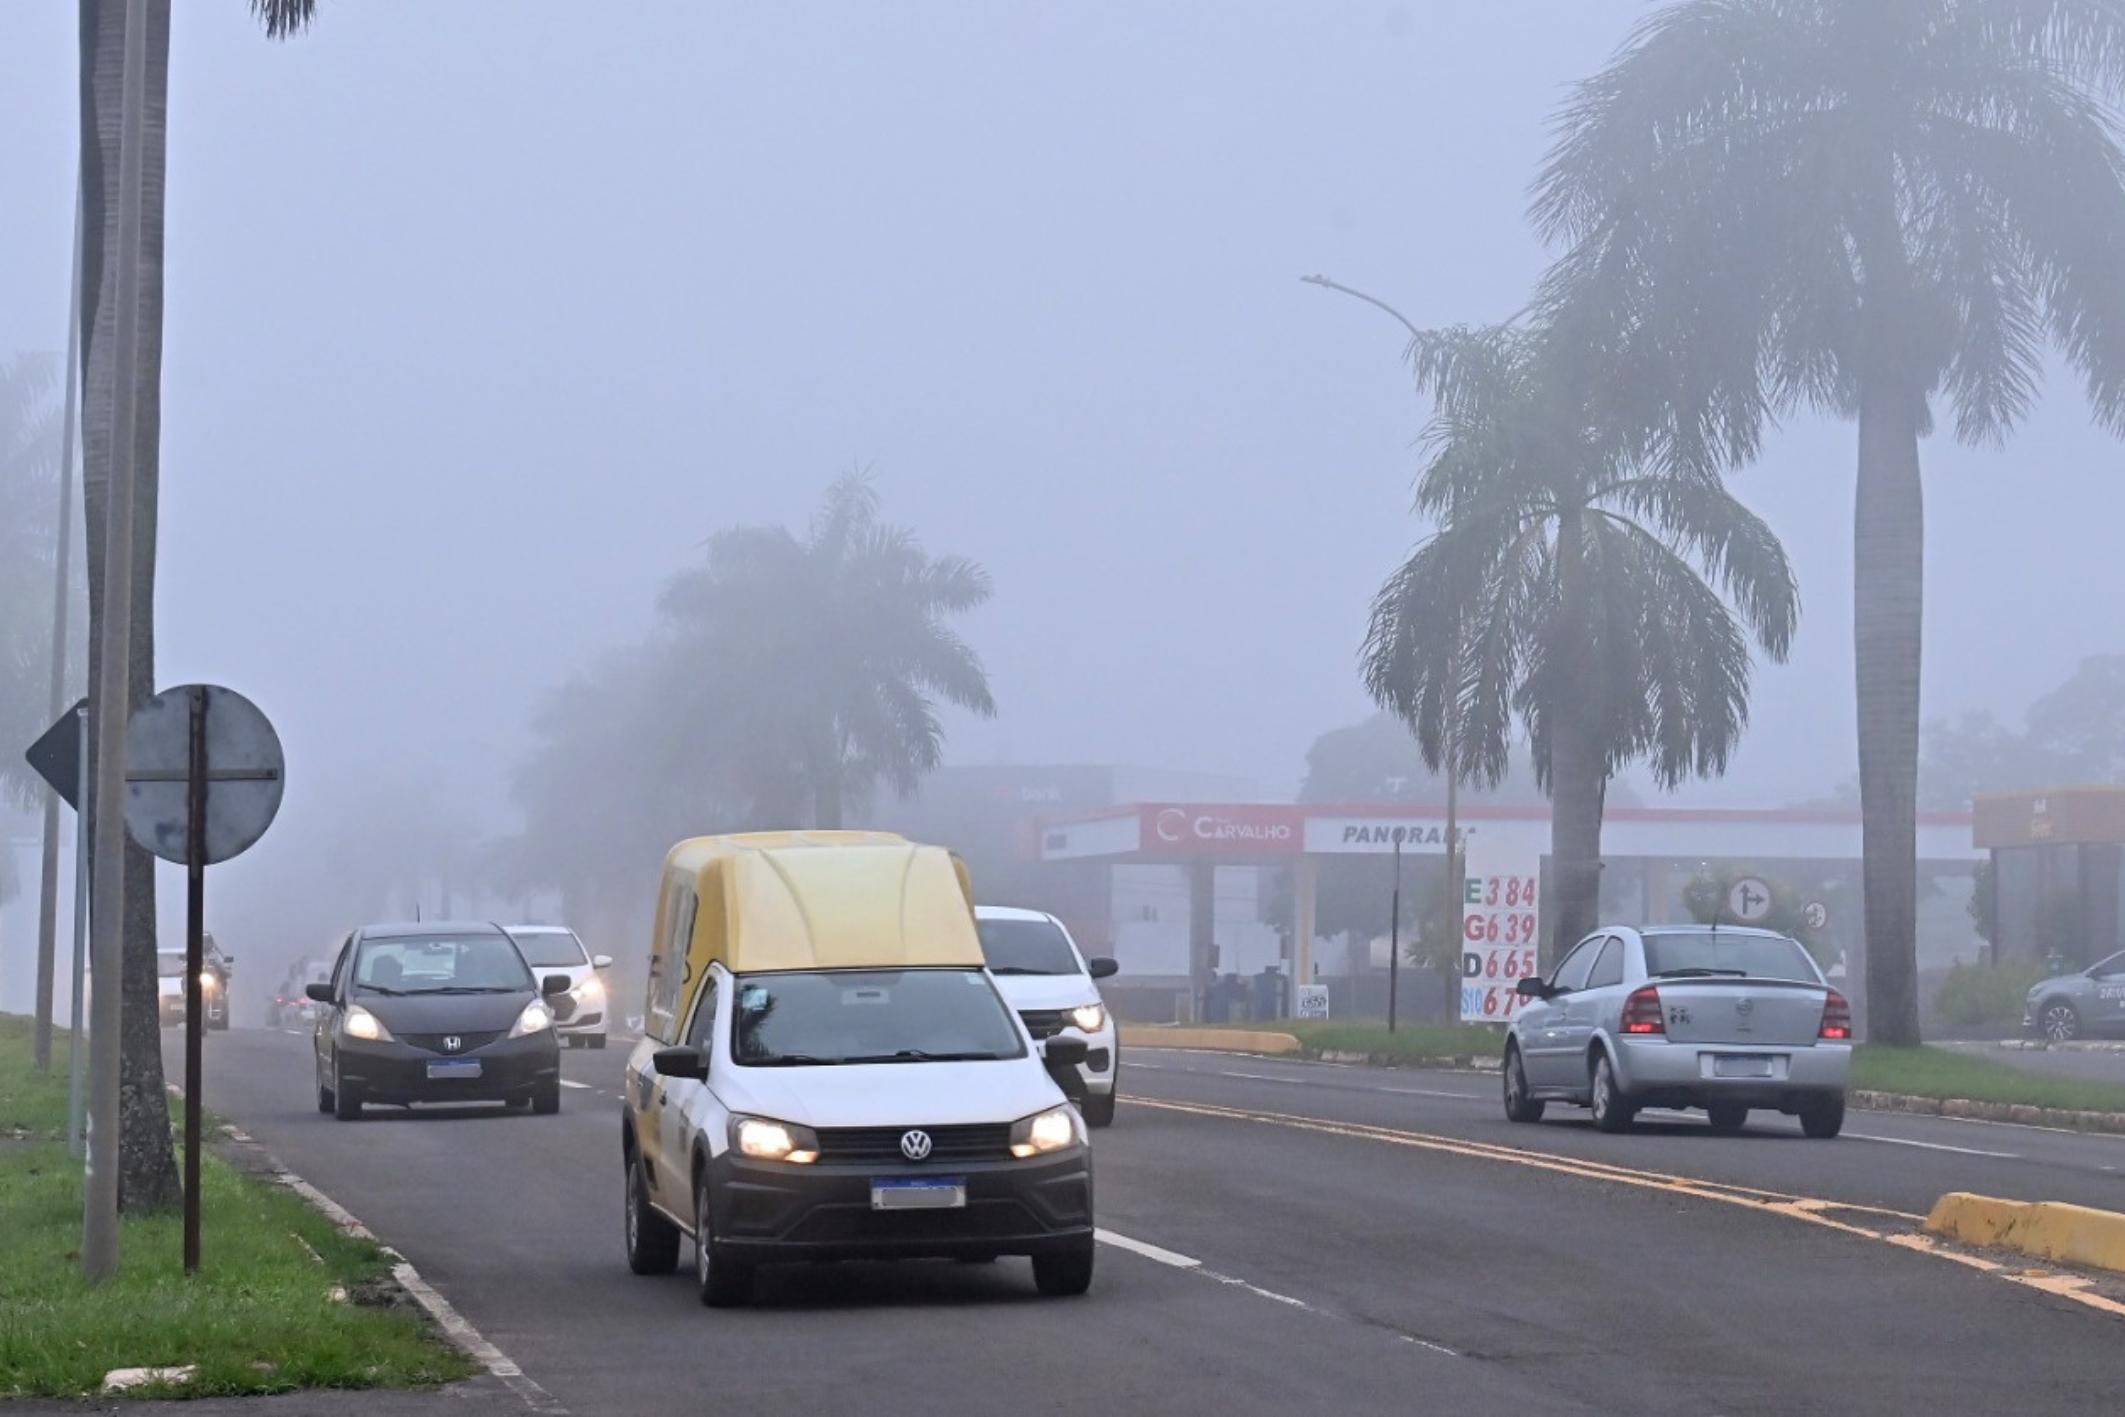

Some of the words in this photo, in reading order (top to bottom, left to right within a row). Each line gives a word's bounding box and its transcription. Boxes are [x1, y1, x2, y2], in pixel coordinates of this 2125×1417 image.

[1193, 816, 1291, 839] CARVALHO
[1464, 878, 1482, 904] E
[1464, 914, 1485, 941] G
[1463, 953, 1482, 978] D
